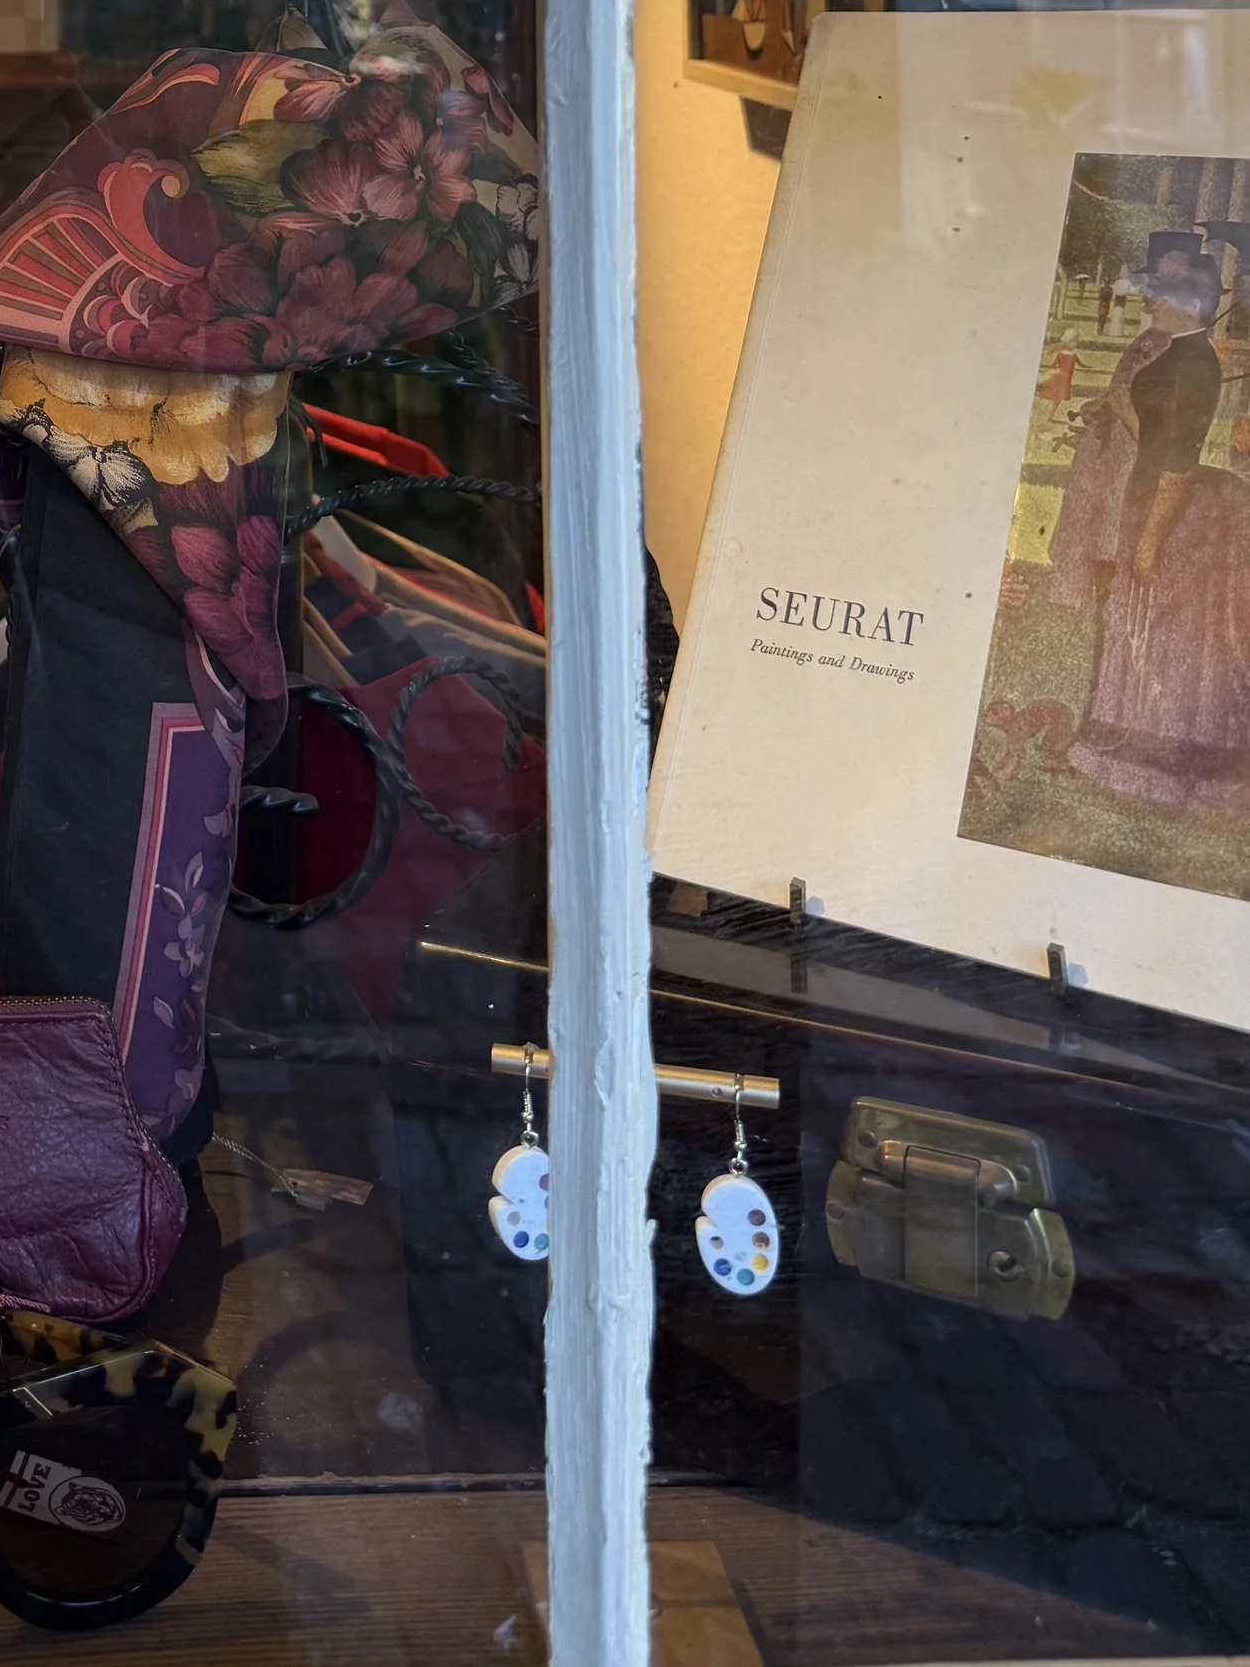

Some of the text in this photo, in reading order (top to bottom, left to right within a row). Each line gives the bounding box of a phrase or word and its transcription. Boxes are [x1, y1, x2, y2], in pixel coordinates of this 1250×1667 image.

[755, 586, 925, 646] SEURAT
[749, 637, 915, 684] Paintings and Drawings
[17, 1462, 52, 1512] LOVE
